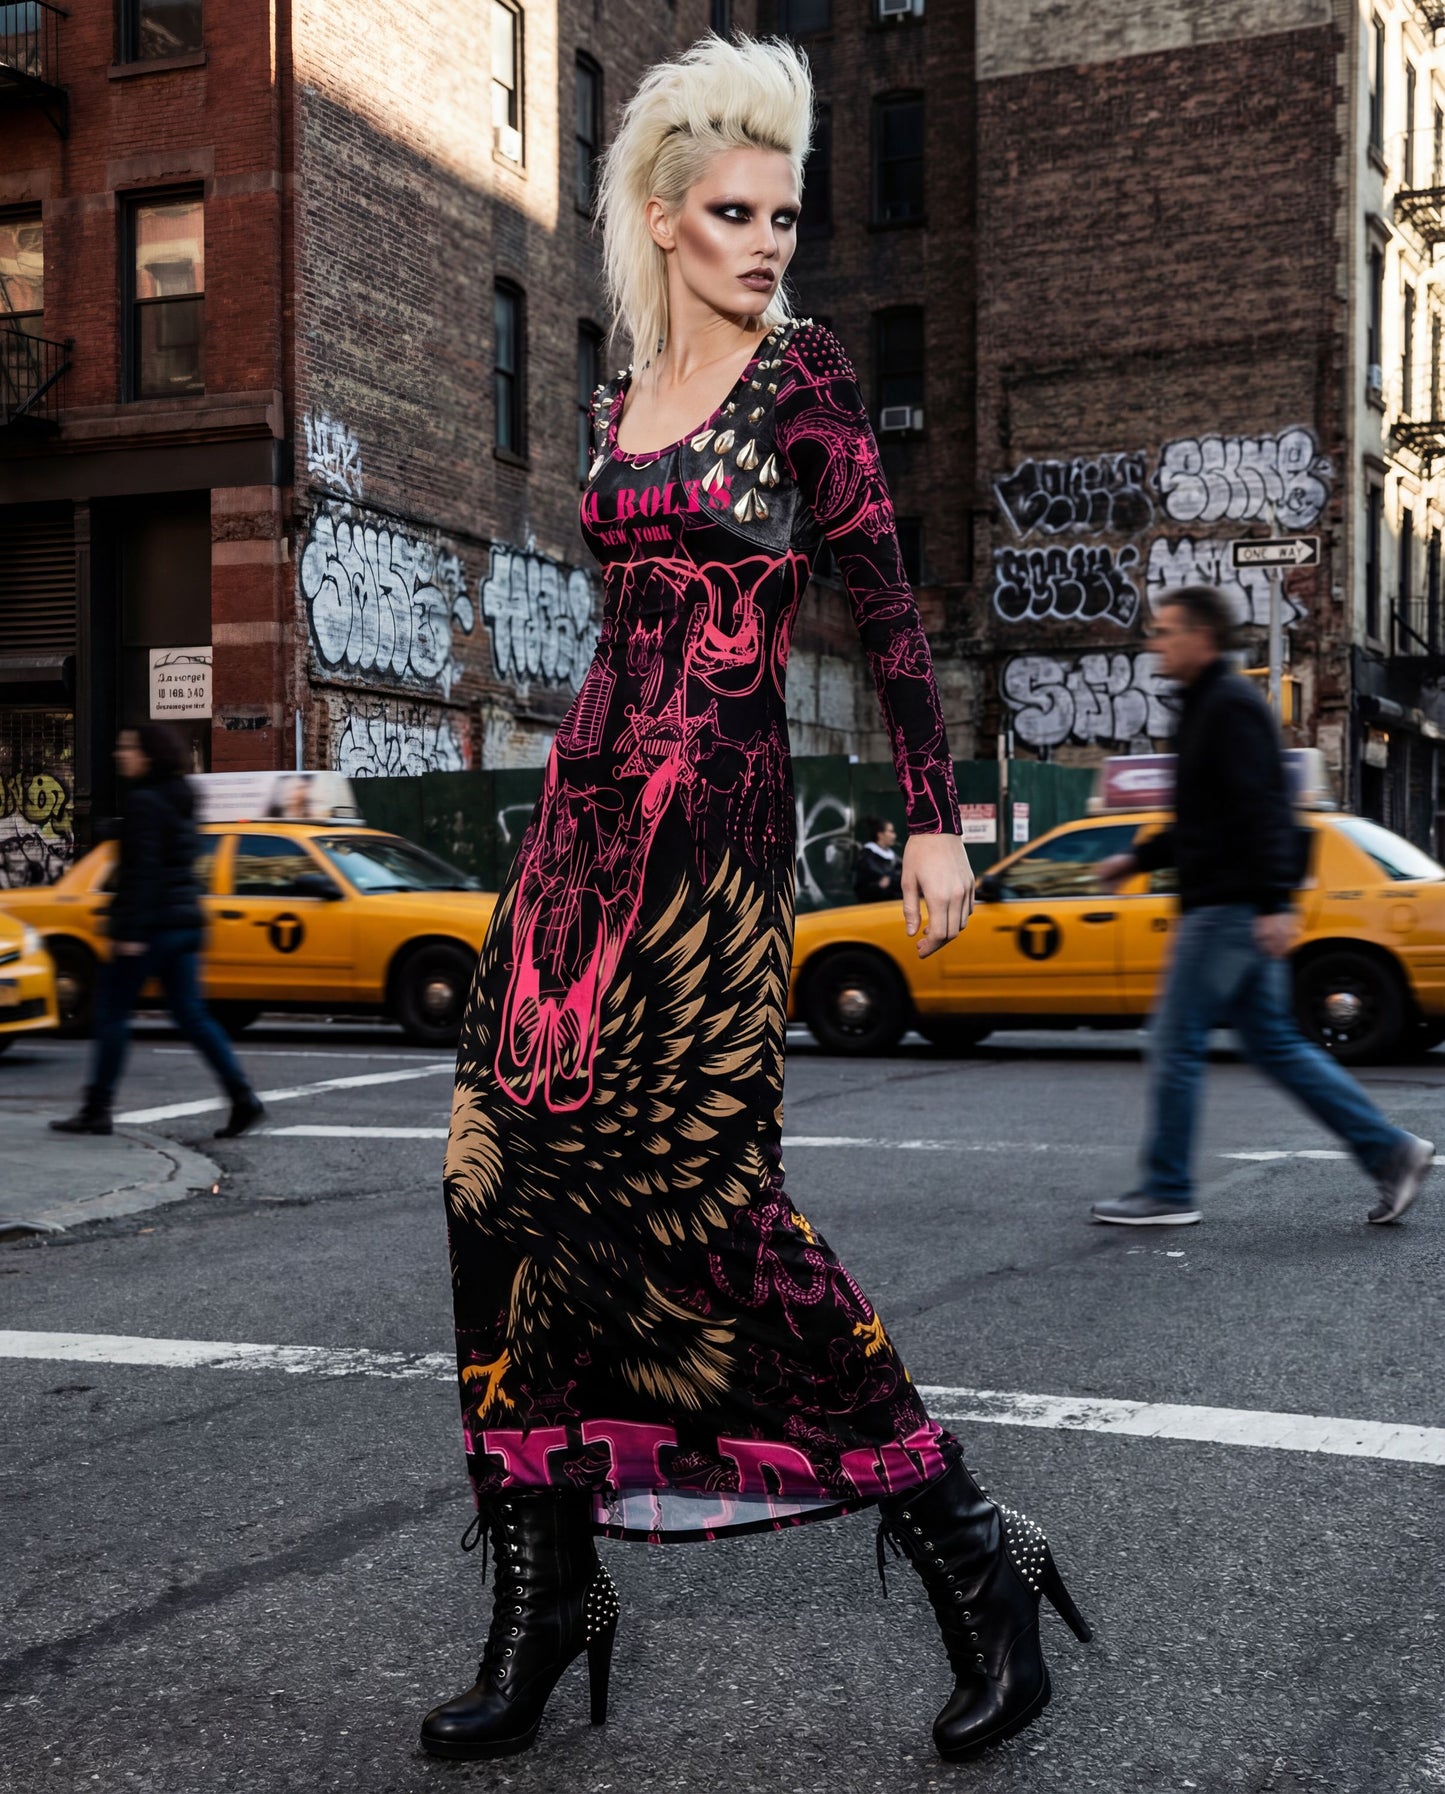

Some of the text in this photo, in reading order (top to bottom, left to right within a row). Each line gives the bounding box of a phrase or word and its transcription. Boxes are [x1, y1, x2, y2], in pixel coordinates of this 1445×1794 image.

[599, 524, 673, 547] NEW YORK
[1279, 546, 1304, 558] WAY
